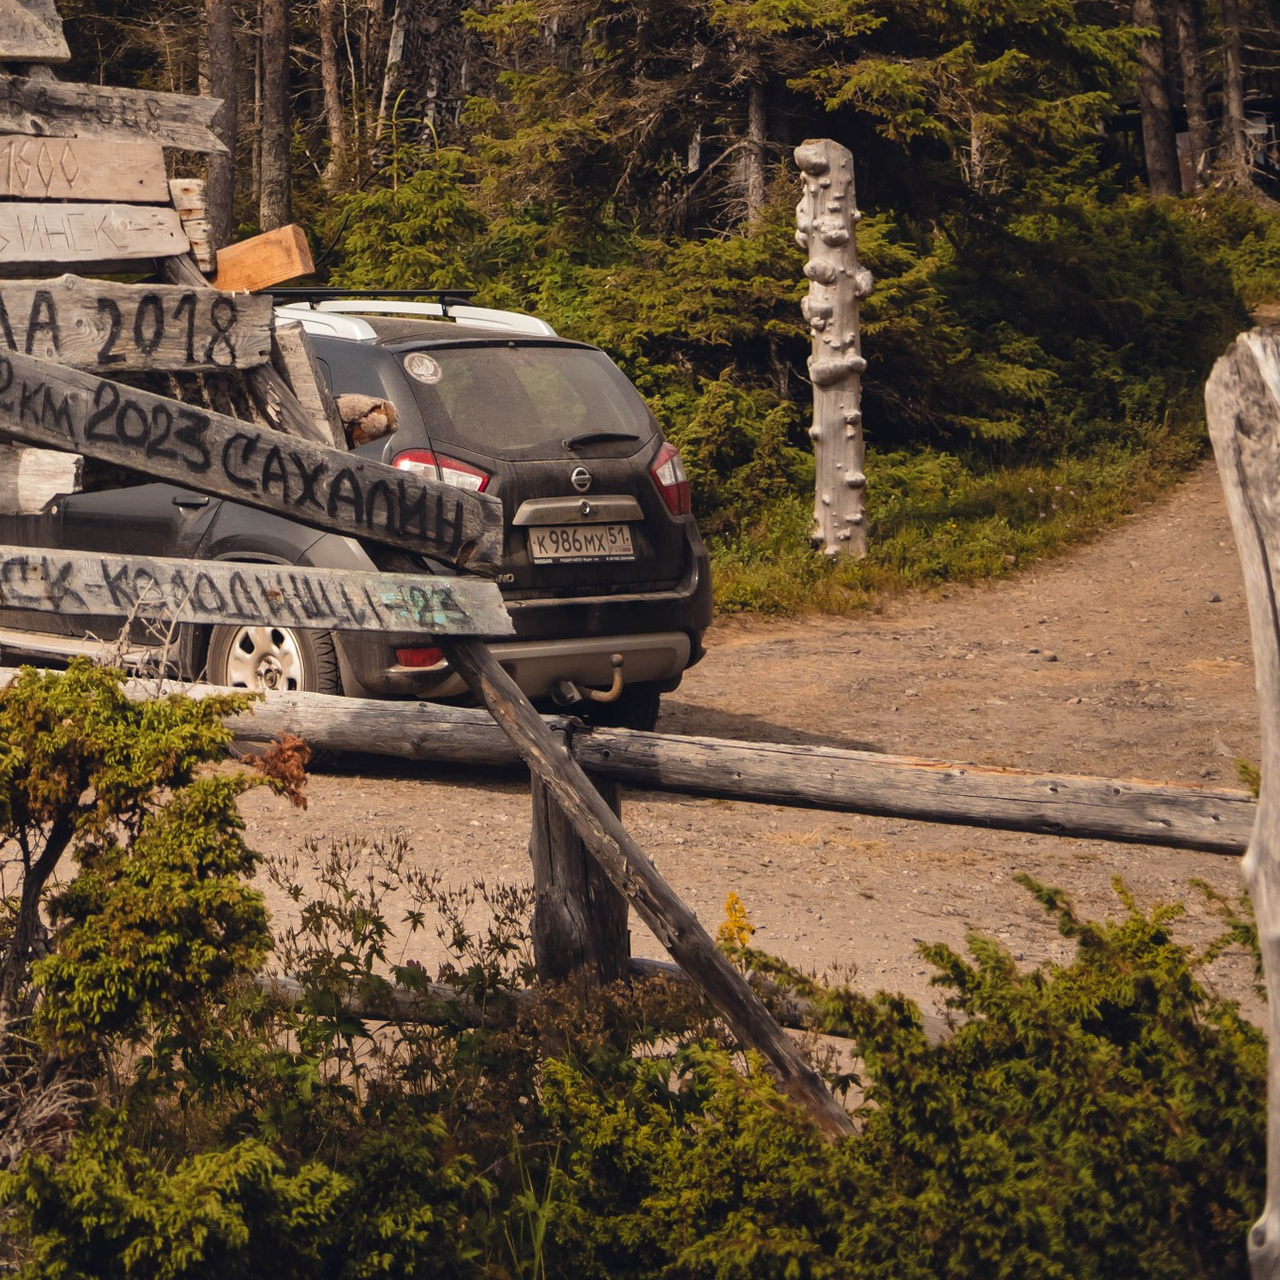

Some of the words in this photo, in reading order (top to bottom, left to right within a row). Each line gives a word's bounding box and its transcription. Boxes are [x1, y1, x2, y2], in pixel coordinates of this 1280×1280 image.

[96, 290, 239, 366] 2018
[85, 379, 213, 474] 2023
[221, 431, 464, 558] САХАЛИН
